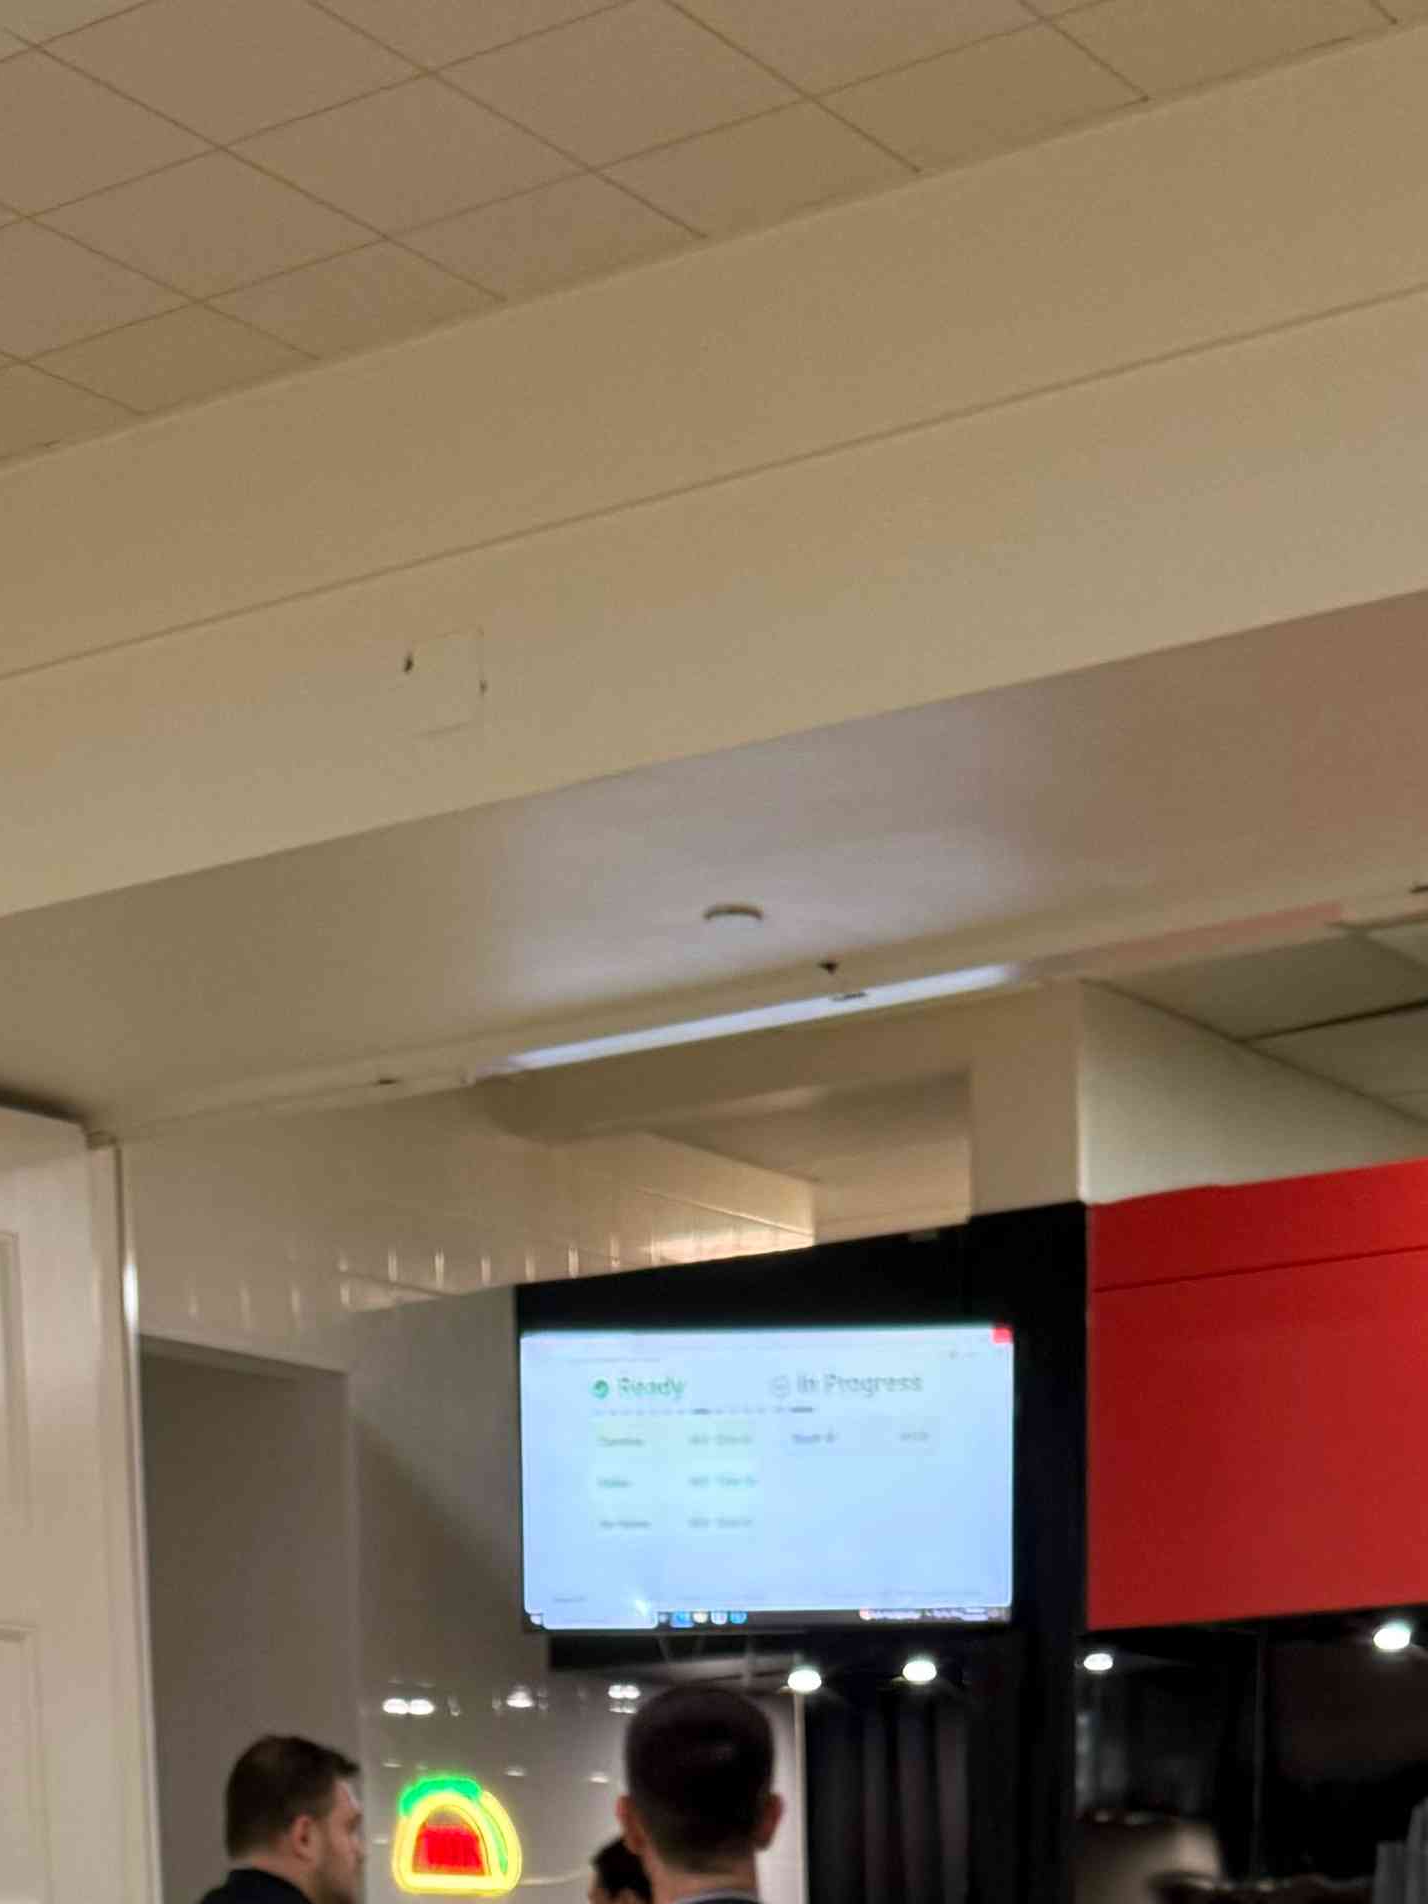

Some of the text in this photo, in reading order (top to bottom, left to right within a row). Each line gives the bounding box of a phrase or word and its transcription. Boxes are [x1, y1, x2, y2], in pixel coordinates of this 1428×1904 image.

[617, 1375, 685, 1401] Ready
[797, 1372, 924, 1398] In Progress
